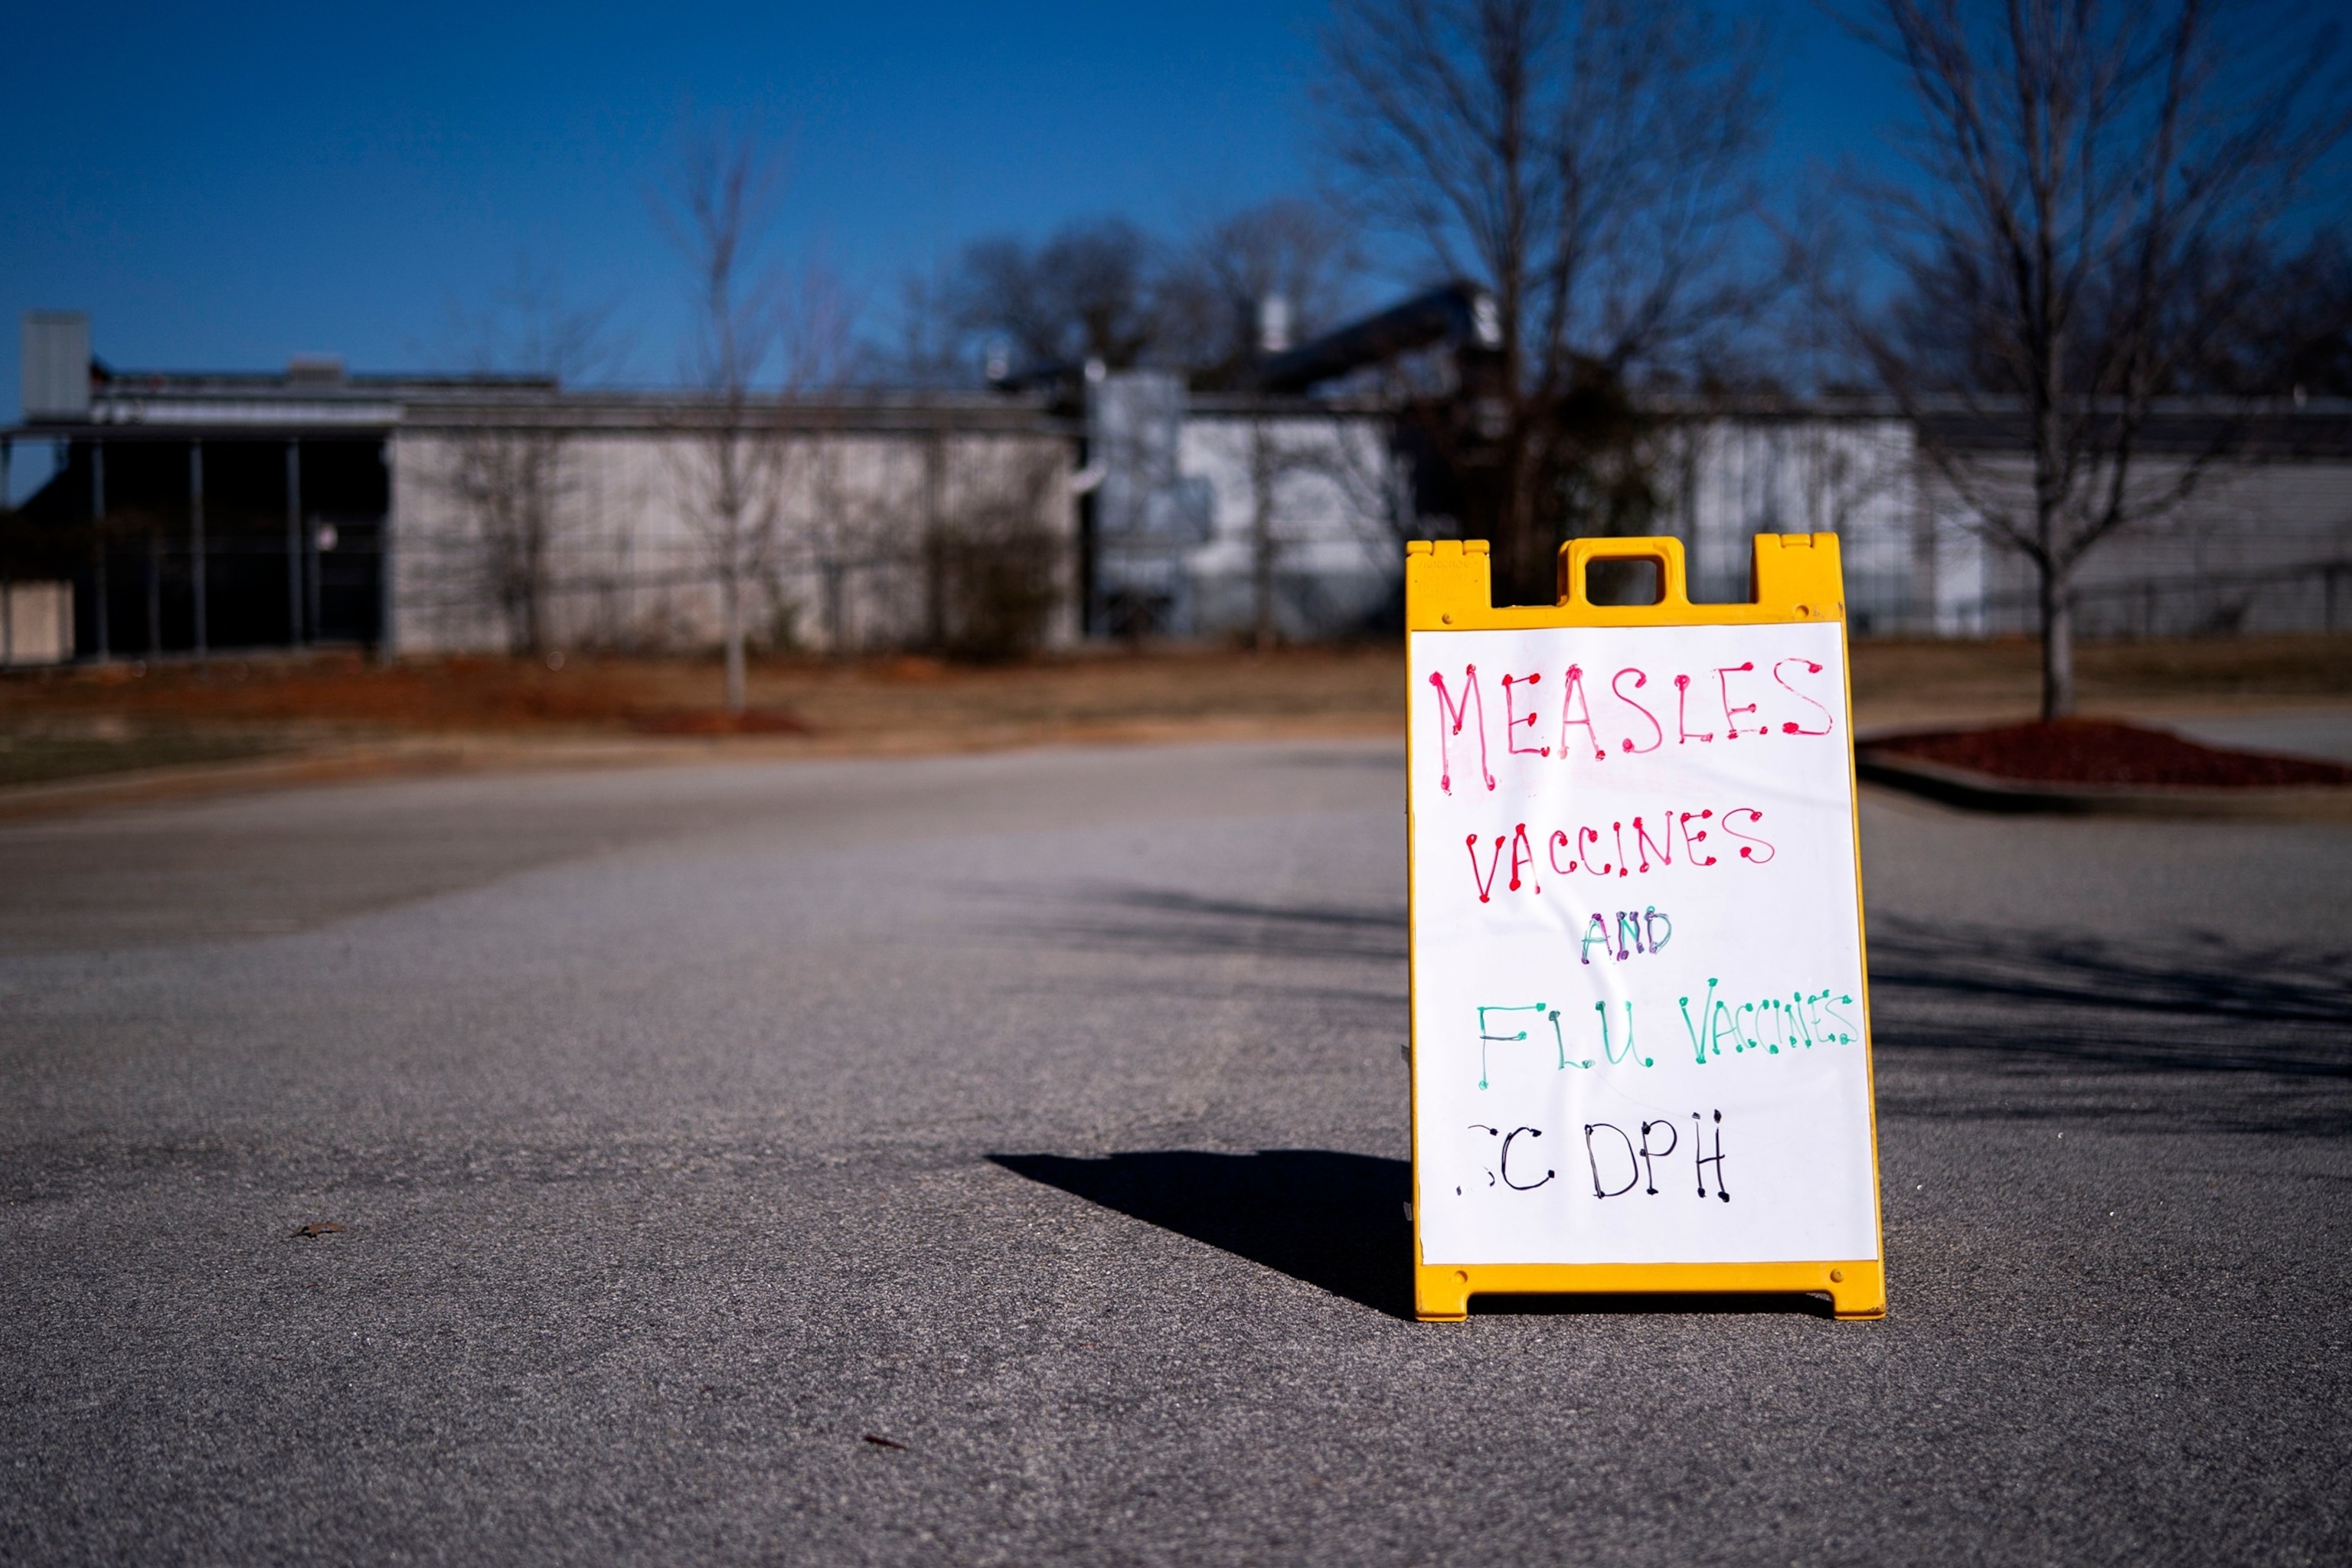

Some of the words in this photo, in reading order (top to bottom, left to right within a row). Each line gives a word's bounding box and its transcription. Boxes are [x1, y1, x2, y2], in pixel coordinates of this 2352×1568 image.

[1429, 658, 1833, 795] MEASLES
[1465, 808, 1775, 903] VACCINES
[1581, 906, 1672, 963] AND
[1477, 1001, 1654, 1090] FLU
[1677, 977, 1858, 1065] VACCINES
[1584, 1109, 1730, 1203] DPH
